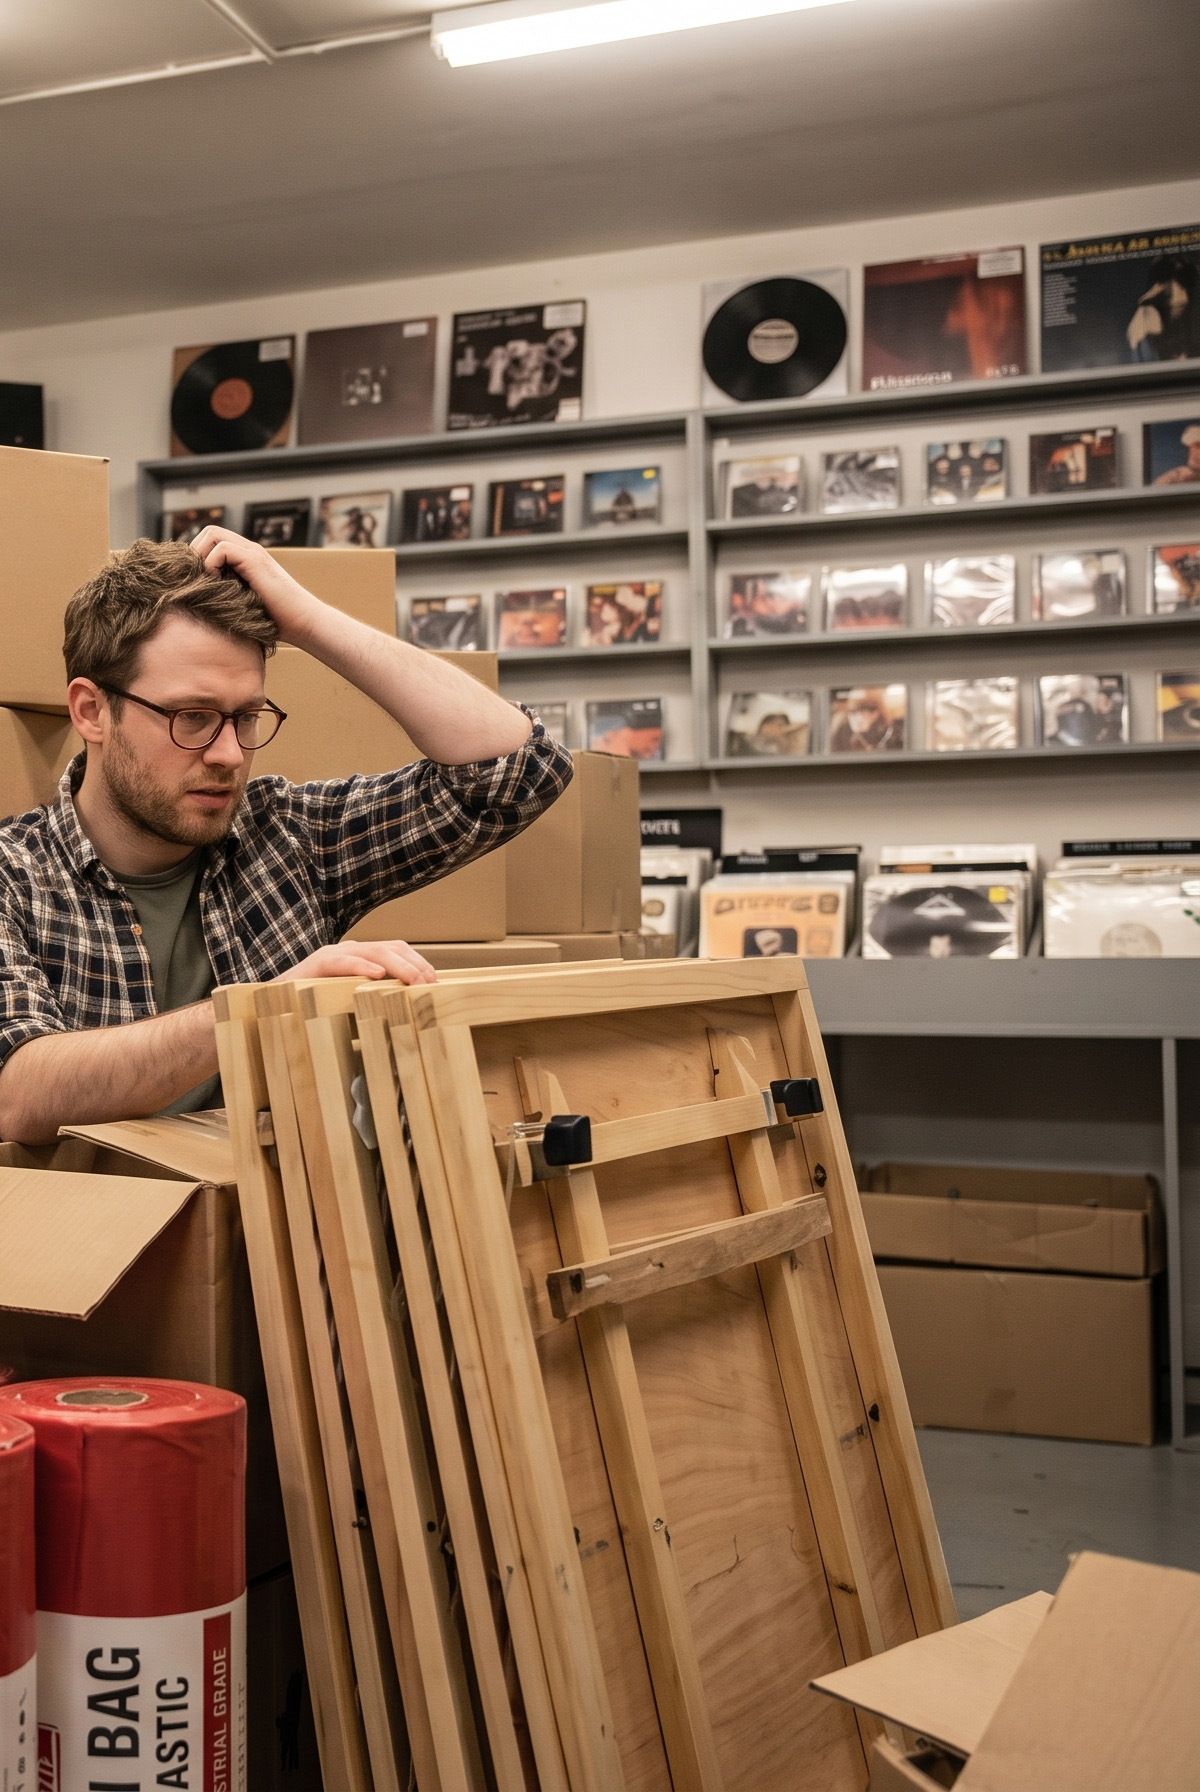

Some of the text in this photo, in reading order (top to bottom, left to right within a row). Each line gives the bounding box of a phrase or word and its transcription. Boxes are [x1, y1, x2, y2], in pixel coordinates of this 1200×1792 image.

[85, 1647, 140, 1758] BAG
[155, 1676, 189, 1790] ASTIC
[213, 1647, 227, 1717] GRADE
